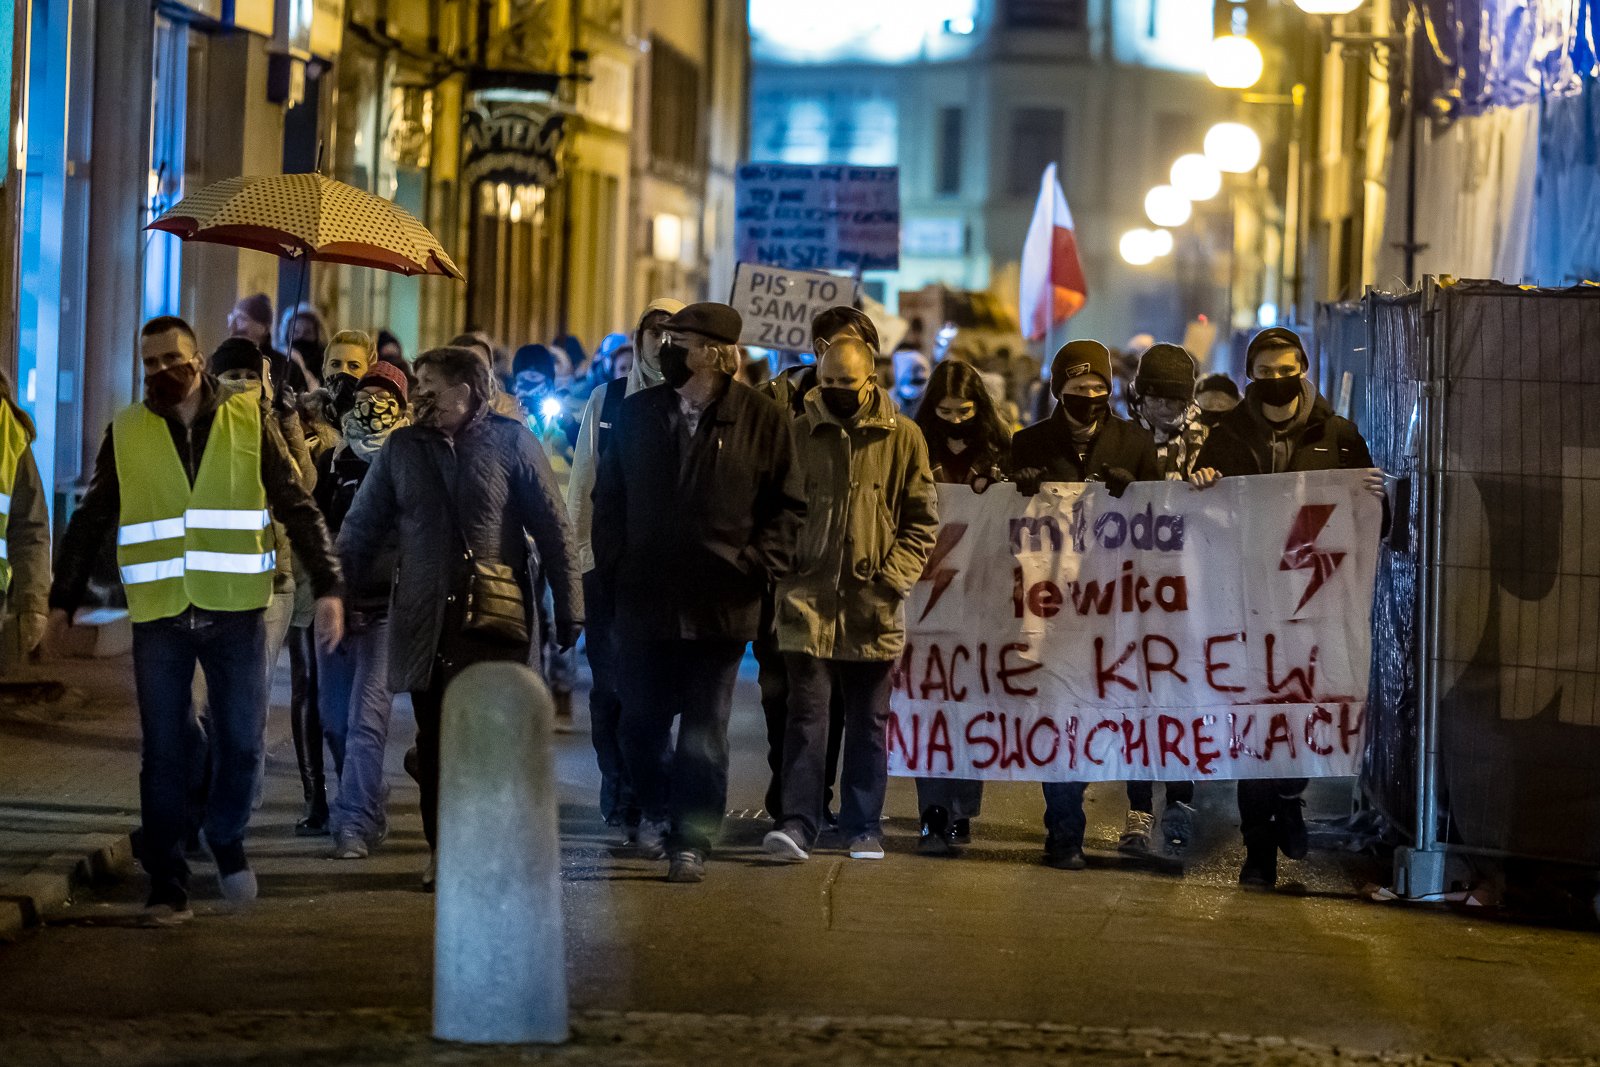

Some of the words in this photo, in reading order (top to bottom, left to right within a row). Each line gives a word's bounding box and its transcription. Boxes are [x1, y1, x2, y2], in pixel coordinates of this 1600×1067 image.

[750, 272, 788, 297] PIS
[805, 279, 838, 302] TO
[1009, 500, 1185, 551] młoda
[1013, 560, 1189, 618] lewica
[1094, 632, 1320, 700] KREW
